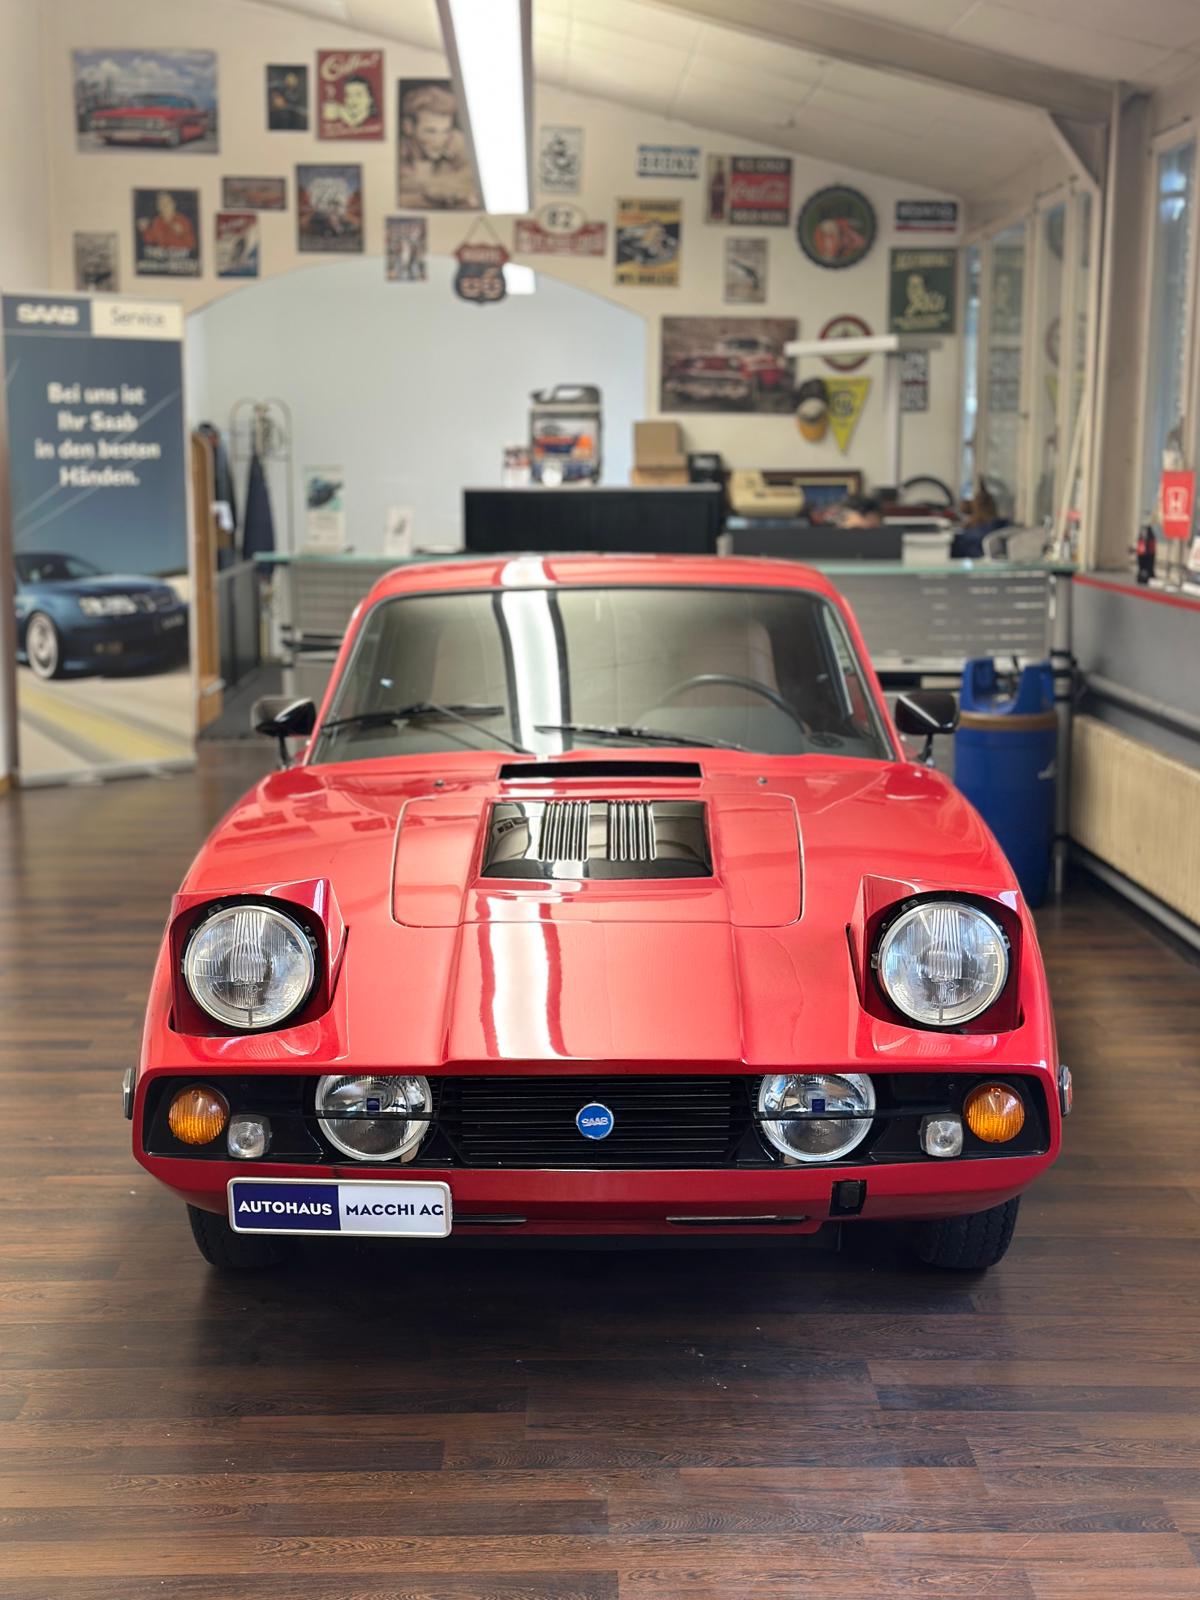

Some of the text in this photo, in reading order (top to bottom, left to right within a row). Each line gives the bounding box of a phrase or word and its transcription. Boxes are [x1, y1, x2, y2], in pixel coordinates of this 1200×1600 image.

[17, 303, 165, 327] SAAB Service
[48, 383, 145, 404] Bei uns ist
[58, 411, 138, 432] Ihr Saab
[35, 438, 161, 459] in den besten
[59, 466, 140, 486] Händen.
[581, 1117, 609, 1127] SAAB
[238, 1200, 444, 1216] AUTOHAUS MACCHI AG
